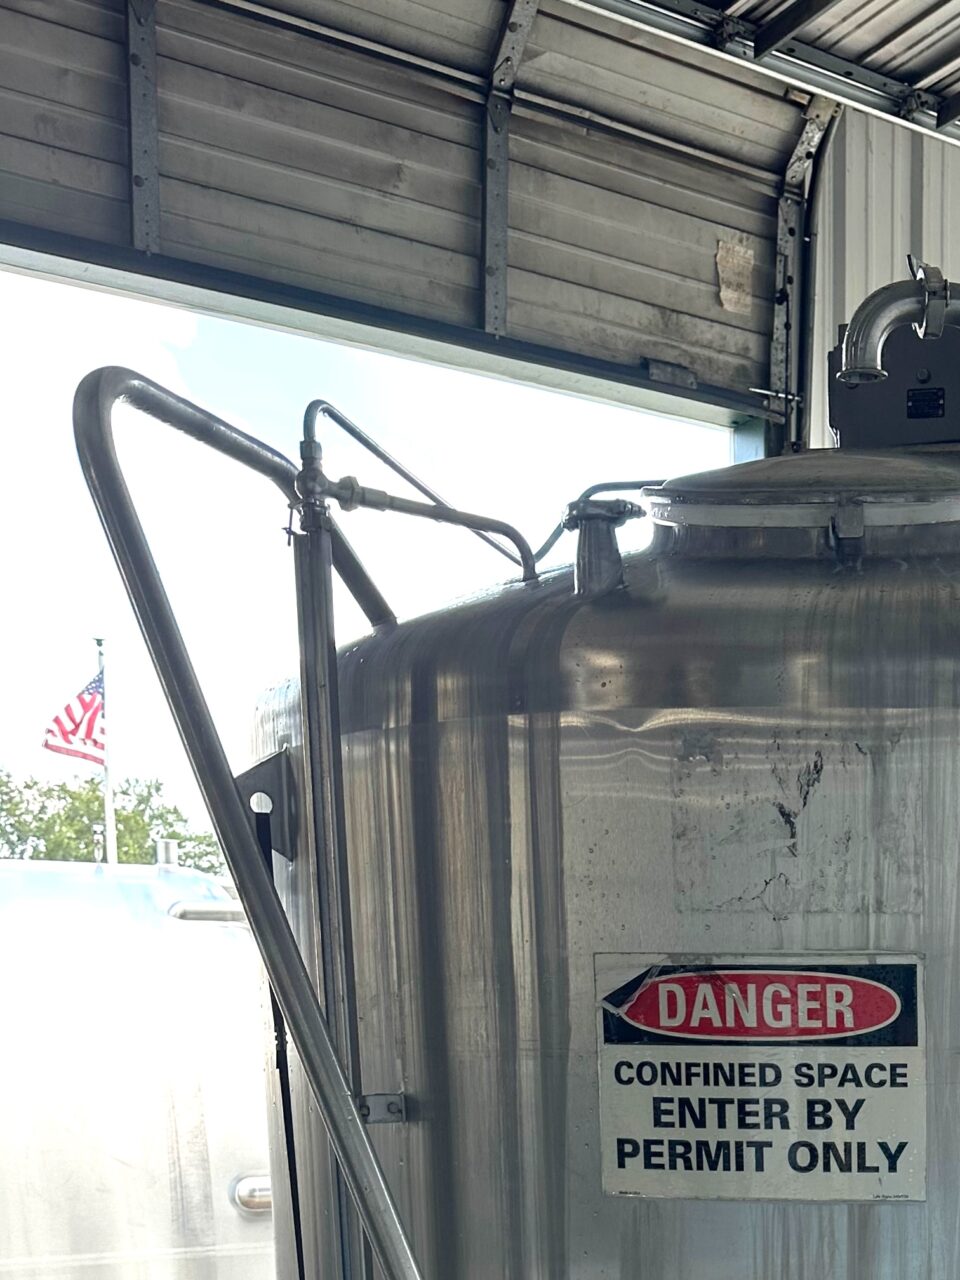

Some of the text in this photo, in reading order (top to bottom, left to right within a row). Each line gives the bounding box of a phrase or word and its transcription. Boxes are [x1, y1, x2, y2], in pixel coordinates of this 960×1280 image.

[658, 983, 855, 1029] DANGER
[614, 1061, 909, 1088] CONFINED SPACE
[652, 1097, 866, 1130] ENTER BY
[616, 1138, 909, 1174] PERMIT ONLY
